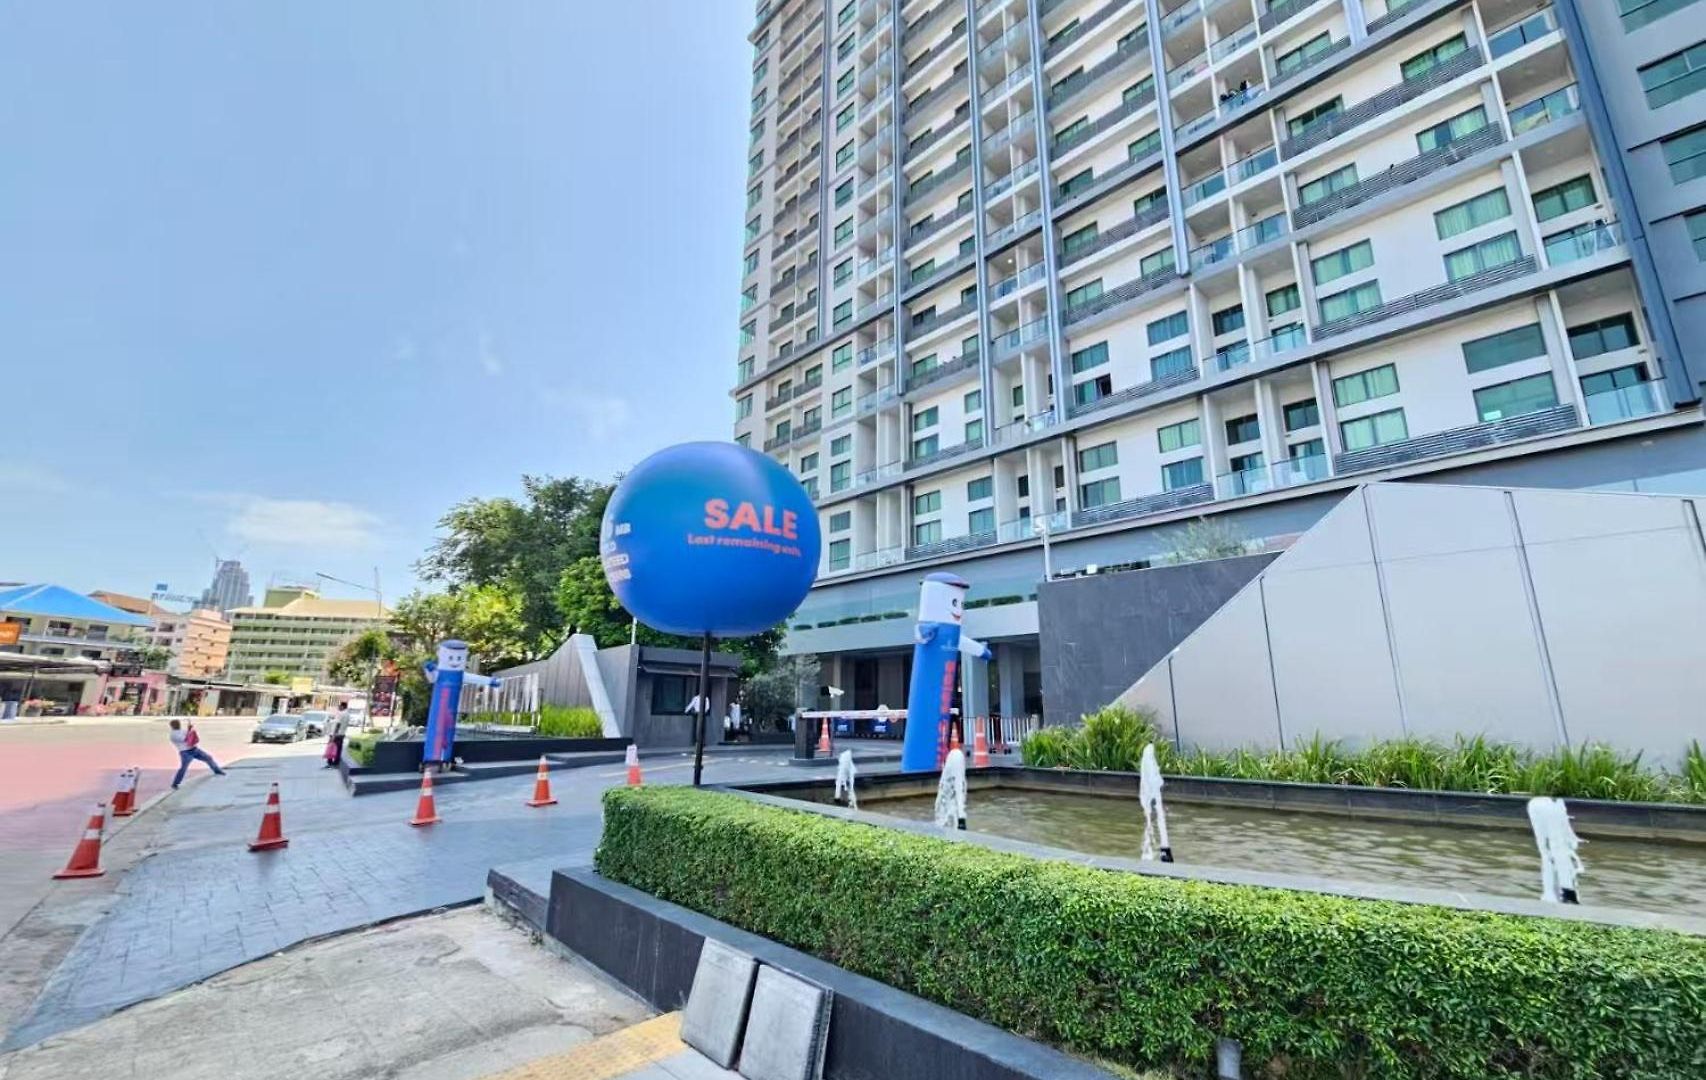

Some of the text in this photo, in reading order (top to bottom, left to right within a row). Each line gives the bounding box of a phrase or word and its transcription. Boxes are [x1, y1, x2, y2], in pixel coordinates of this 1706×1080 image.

[704, 498, 798, 540] SALE
[687, 533, 715, 545] Last
[717, 536, 781, 555] remaining
